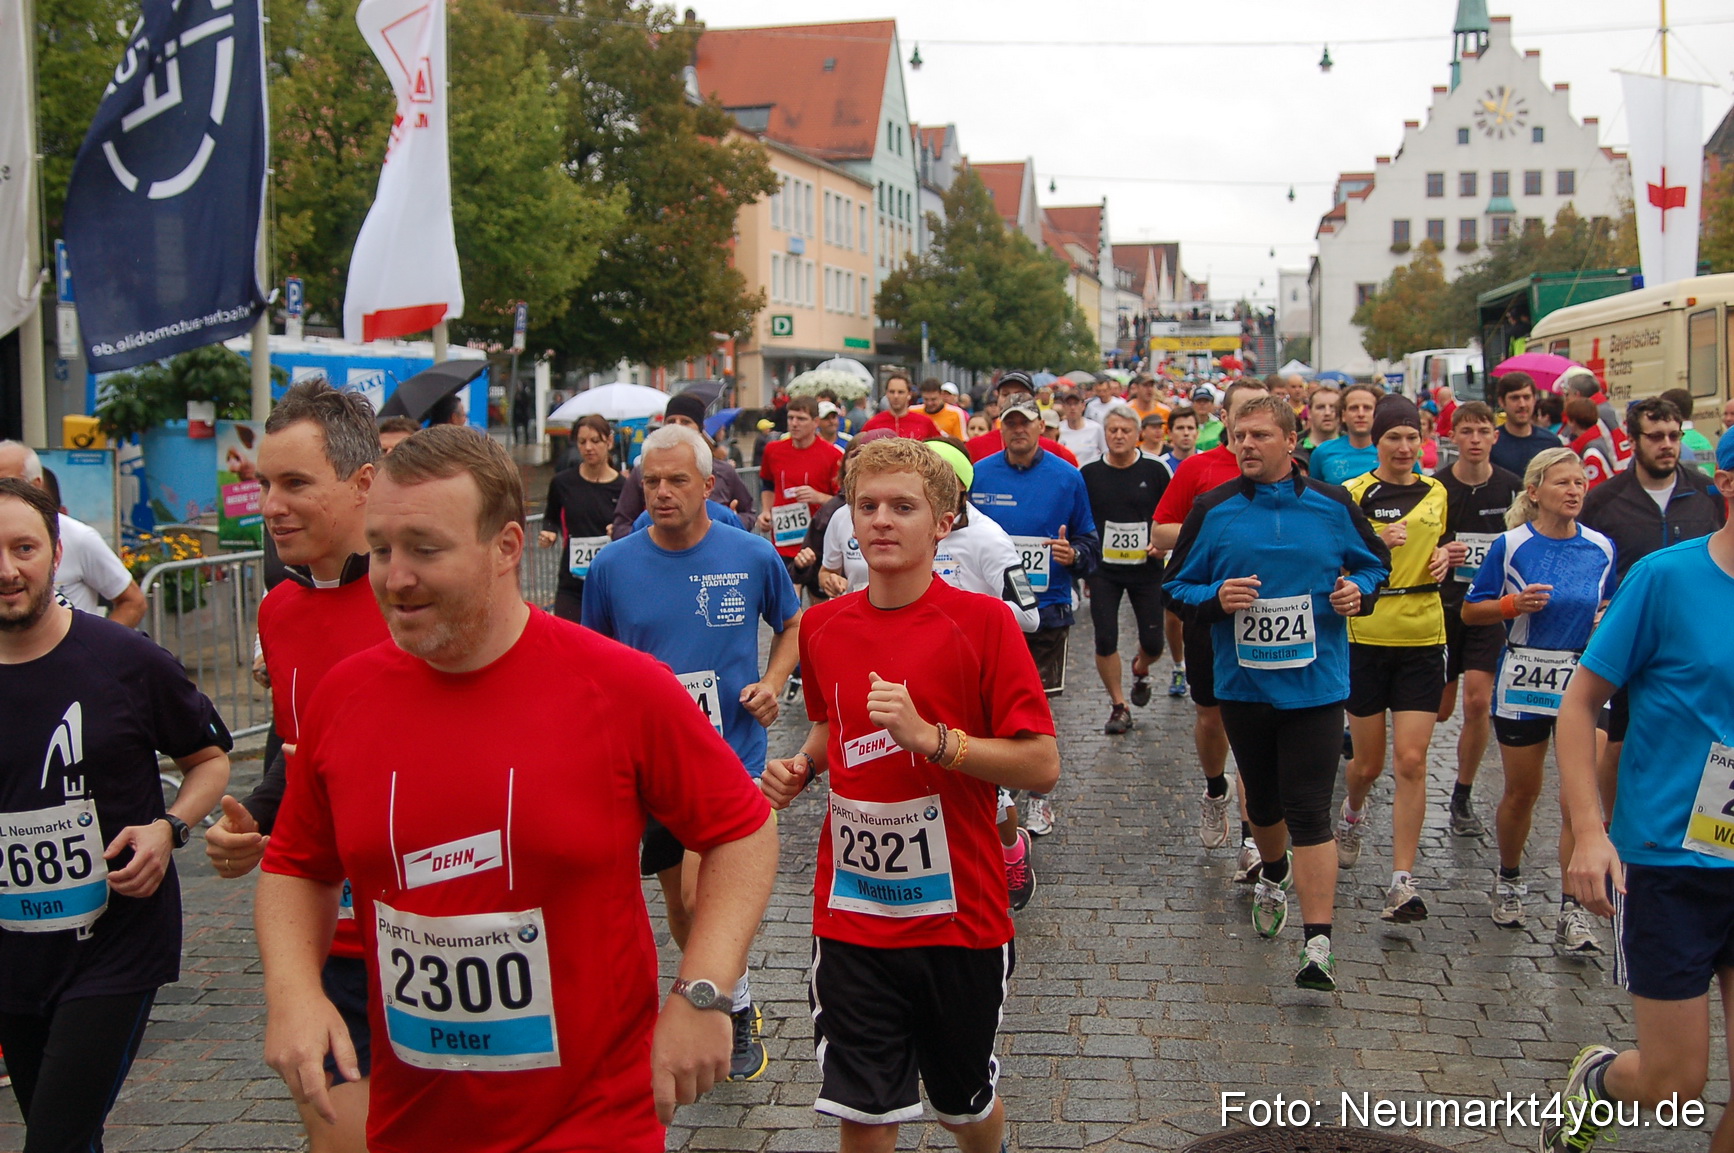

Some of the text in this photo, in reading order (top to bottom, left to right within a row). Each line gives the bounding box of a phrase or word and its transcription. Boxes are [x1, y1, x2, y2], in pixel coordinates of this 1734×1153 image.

[774, 318, 791, 334] D
[1610, 329, 1661, 355] Bayerisches
[1374, 508, 1402, 518] Birgit
[1112, 534, 1139, 548] 233
[575, 547, 601, 565] 24
[1017, 550, 1044, 570] 82
[1465, 547, 1486, 565] 25
[689, 573, 749, 583] 12. NEUMARKTER
[701, 579, 740, 587] STADTLAUF
[1261, 604, 1299, 614] Neumarkt
[1243, 614, 1307, 643] 2824
[1252, 648, 1298, 659] Christian
[1534, 657, 1568, 665] Neumarkt
[1512, 664, 1574, 691] 2447
[1526, 694, 1555, 708] Conny
[858, 737, 886, 756] DEHN
[831, 803, 919, 826] PARTL Neumarkt
[9, 820, 73, 837] Neumarkt
[840, 825, 933, 873] 2321
[432, 847, 475, 872] DEHN
[857, 879, 923, 901] Matthias
[21, 899, 64, 919] Ryan
[378, 917, 511, 949] PARTL Neumarkt
[391, 948, 533, 1014] 2300
[430, 1026, 491, 1051] Peter
